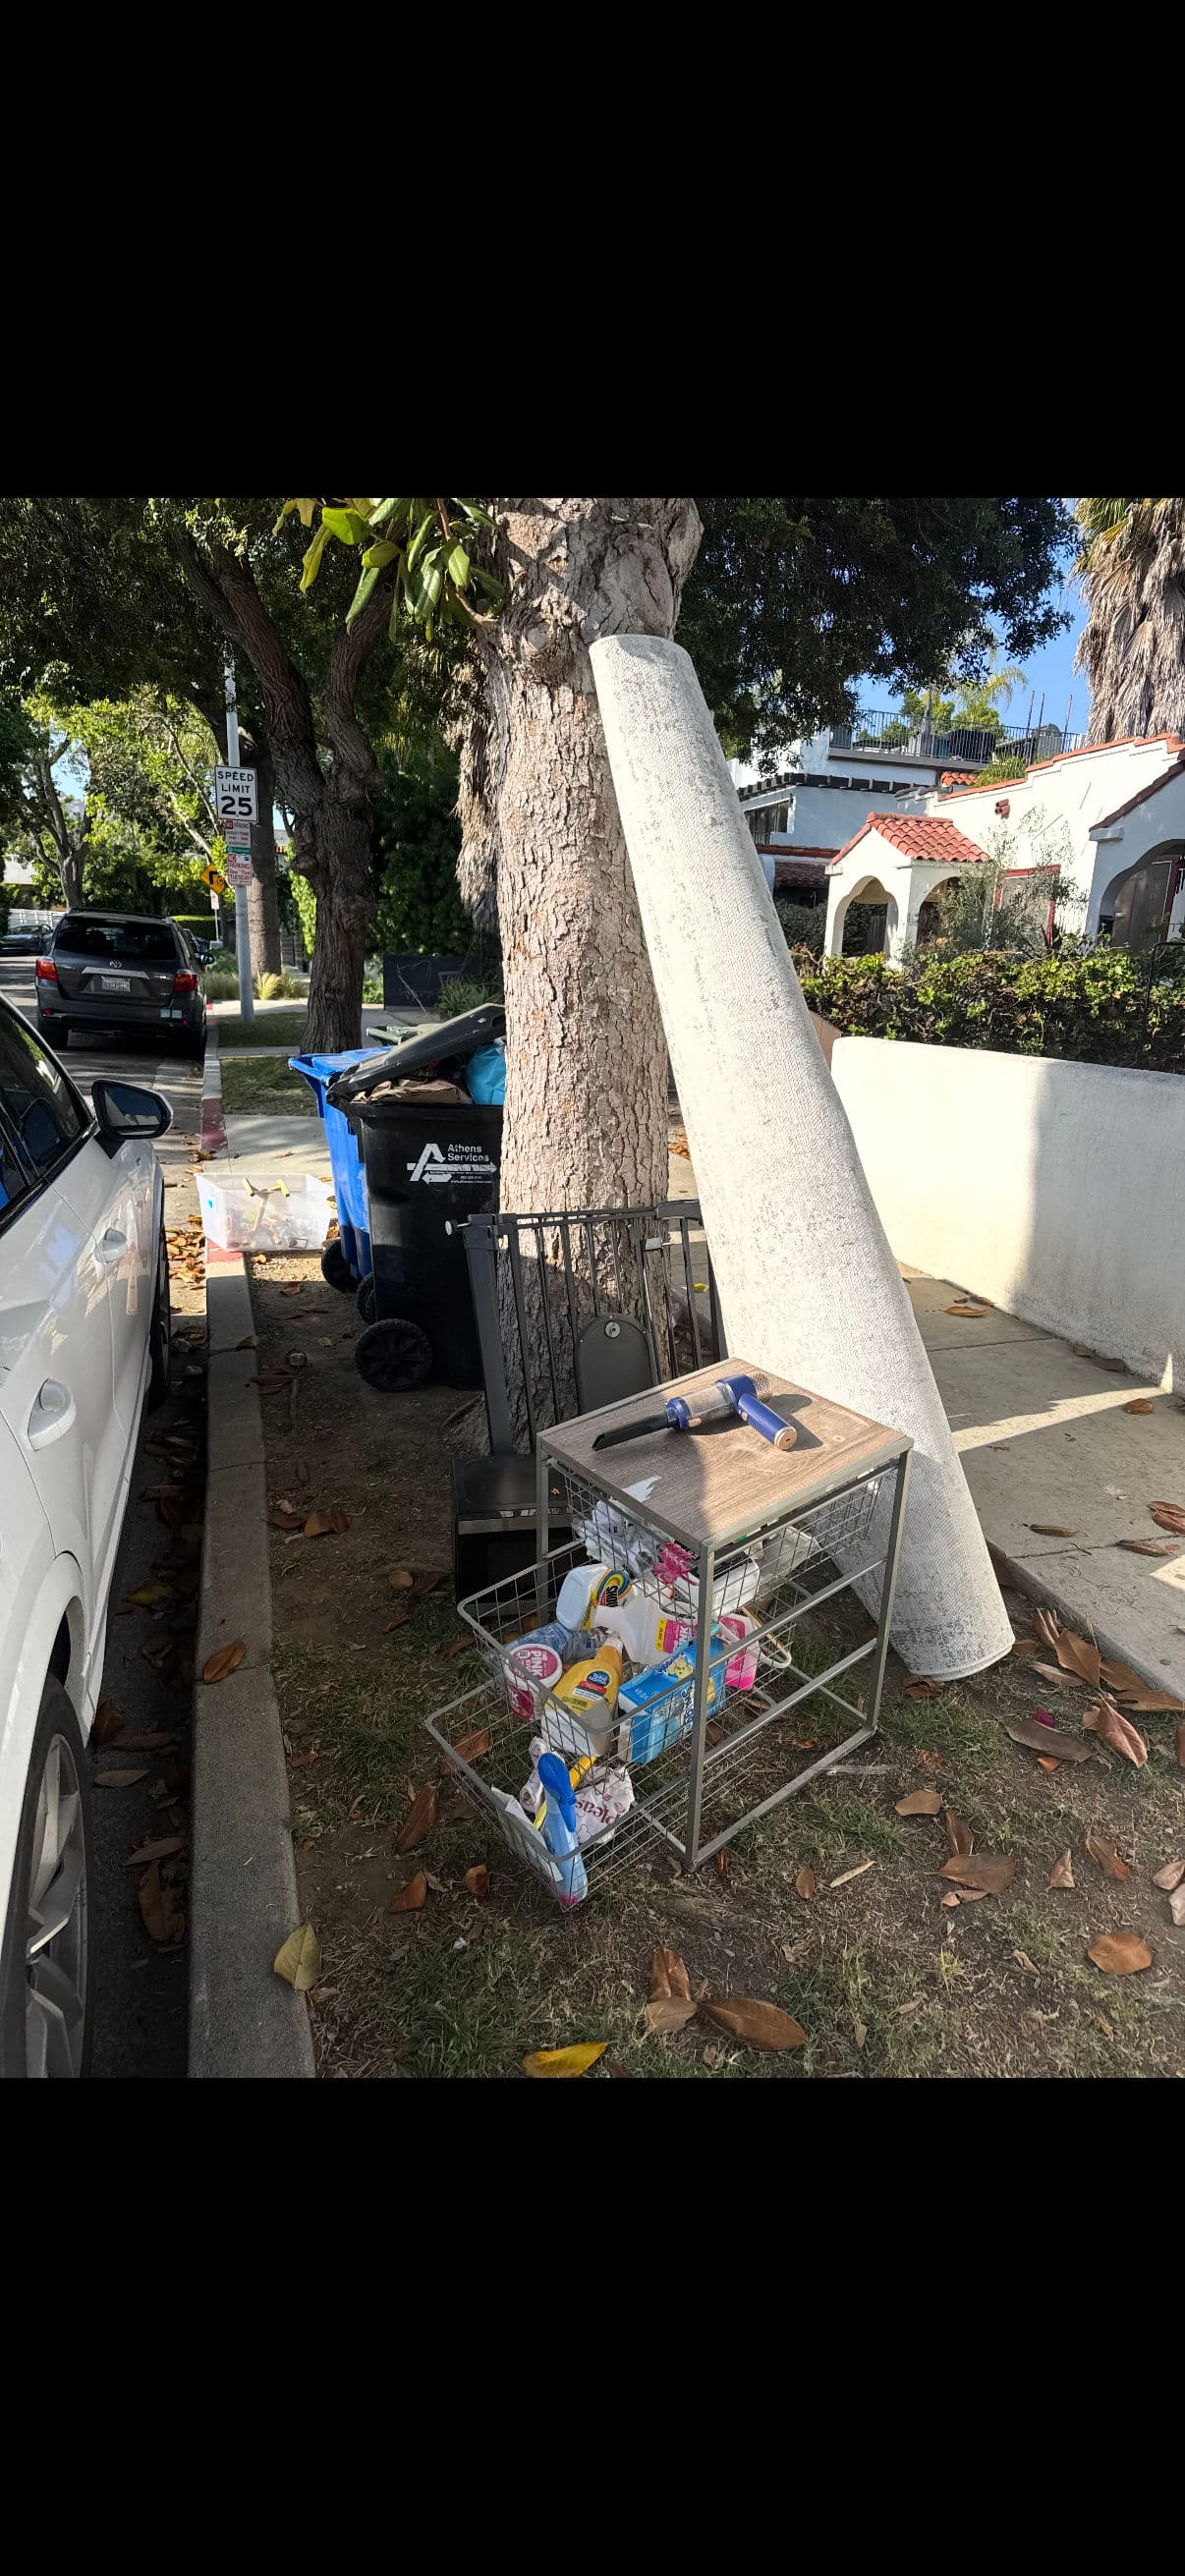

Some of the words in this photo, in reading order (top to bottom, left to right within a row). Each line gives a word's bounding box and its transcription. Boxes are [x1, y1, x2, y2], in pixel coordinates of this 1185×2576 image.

[218, 771, 254, 781] SPEED
[222, 783, 251, 793] LIMIT
[221, 796, 253, 815] 25
[447, 1144, 482, 1152] Athens
[447, 1152, 489, 1162] Services
[532, 1650, 543, 1677] PINK
